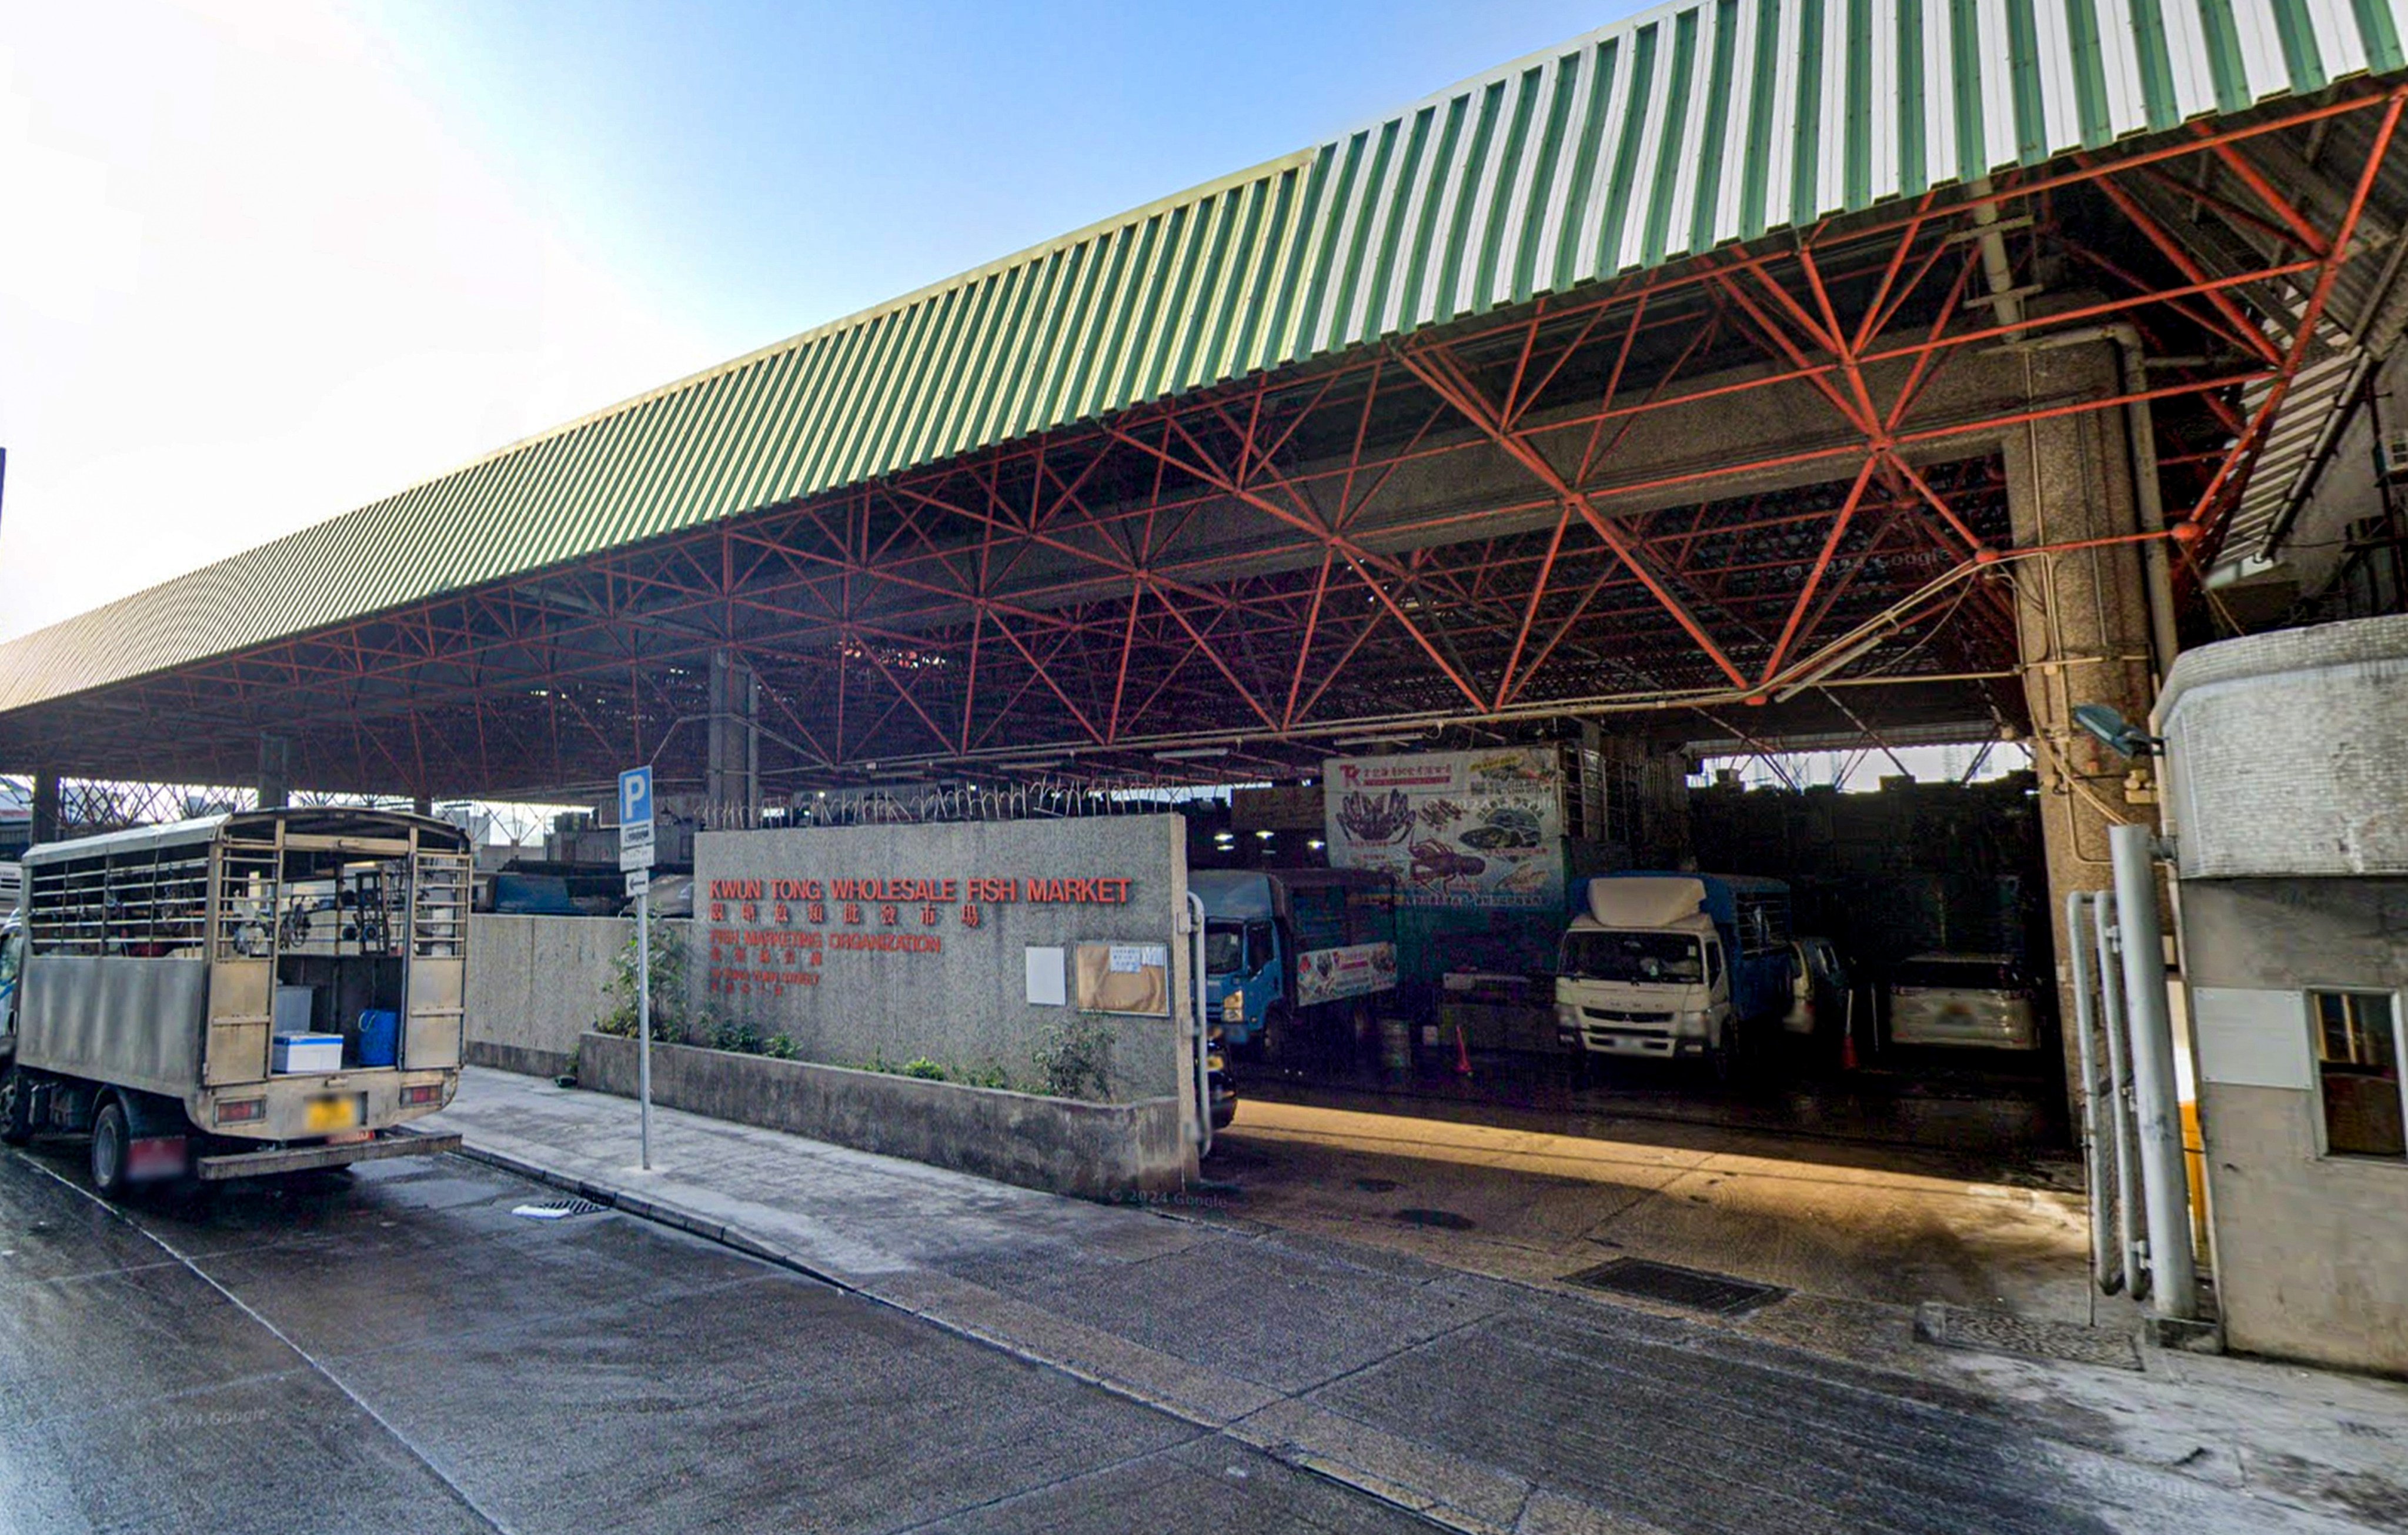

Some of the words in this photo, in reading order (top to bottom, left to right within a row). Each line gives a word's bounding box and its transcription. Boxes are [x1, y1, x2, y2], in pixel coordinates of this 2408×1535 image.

[624, 775, 646, 819] P
[709, 879, 761, 899] KWUN
[770, 879, 822, 900] TONG
[830, 879, 956, 902] WHOLESALE
[967, 878, 1017, 903] FISH
[1028, 878, 1133, 903] MARKET
[829, 932, 941, 953] ORGANIZATION
